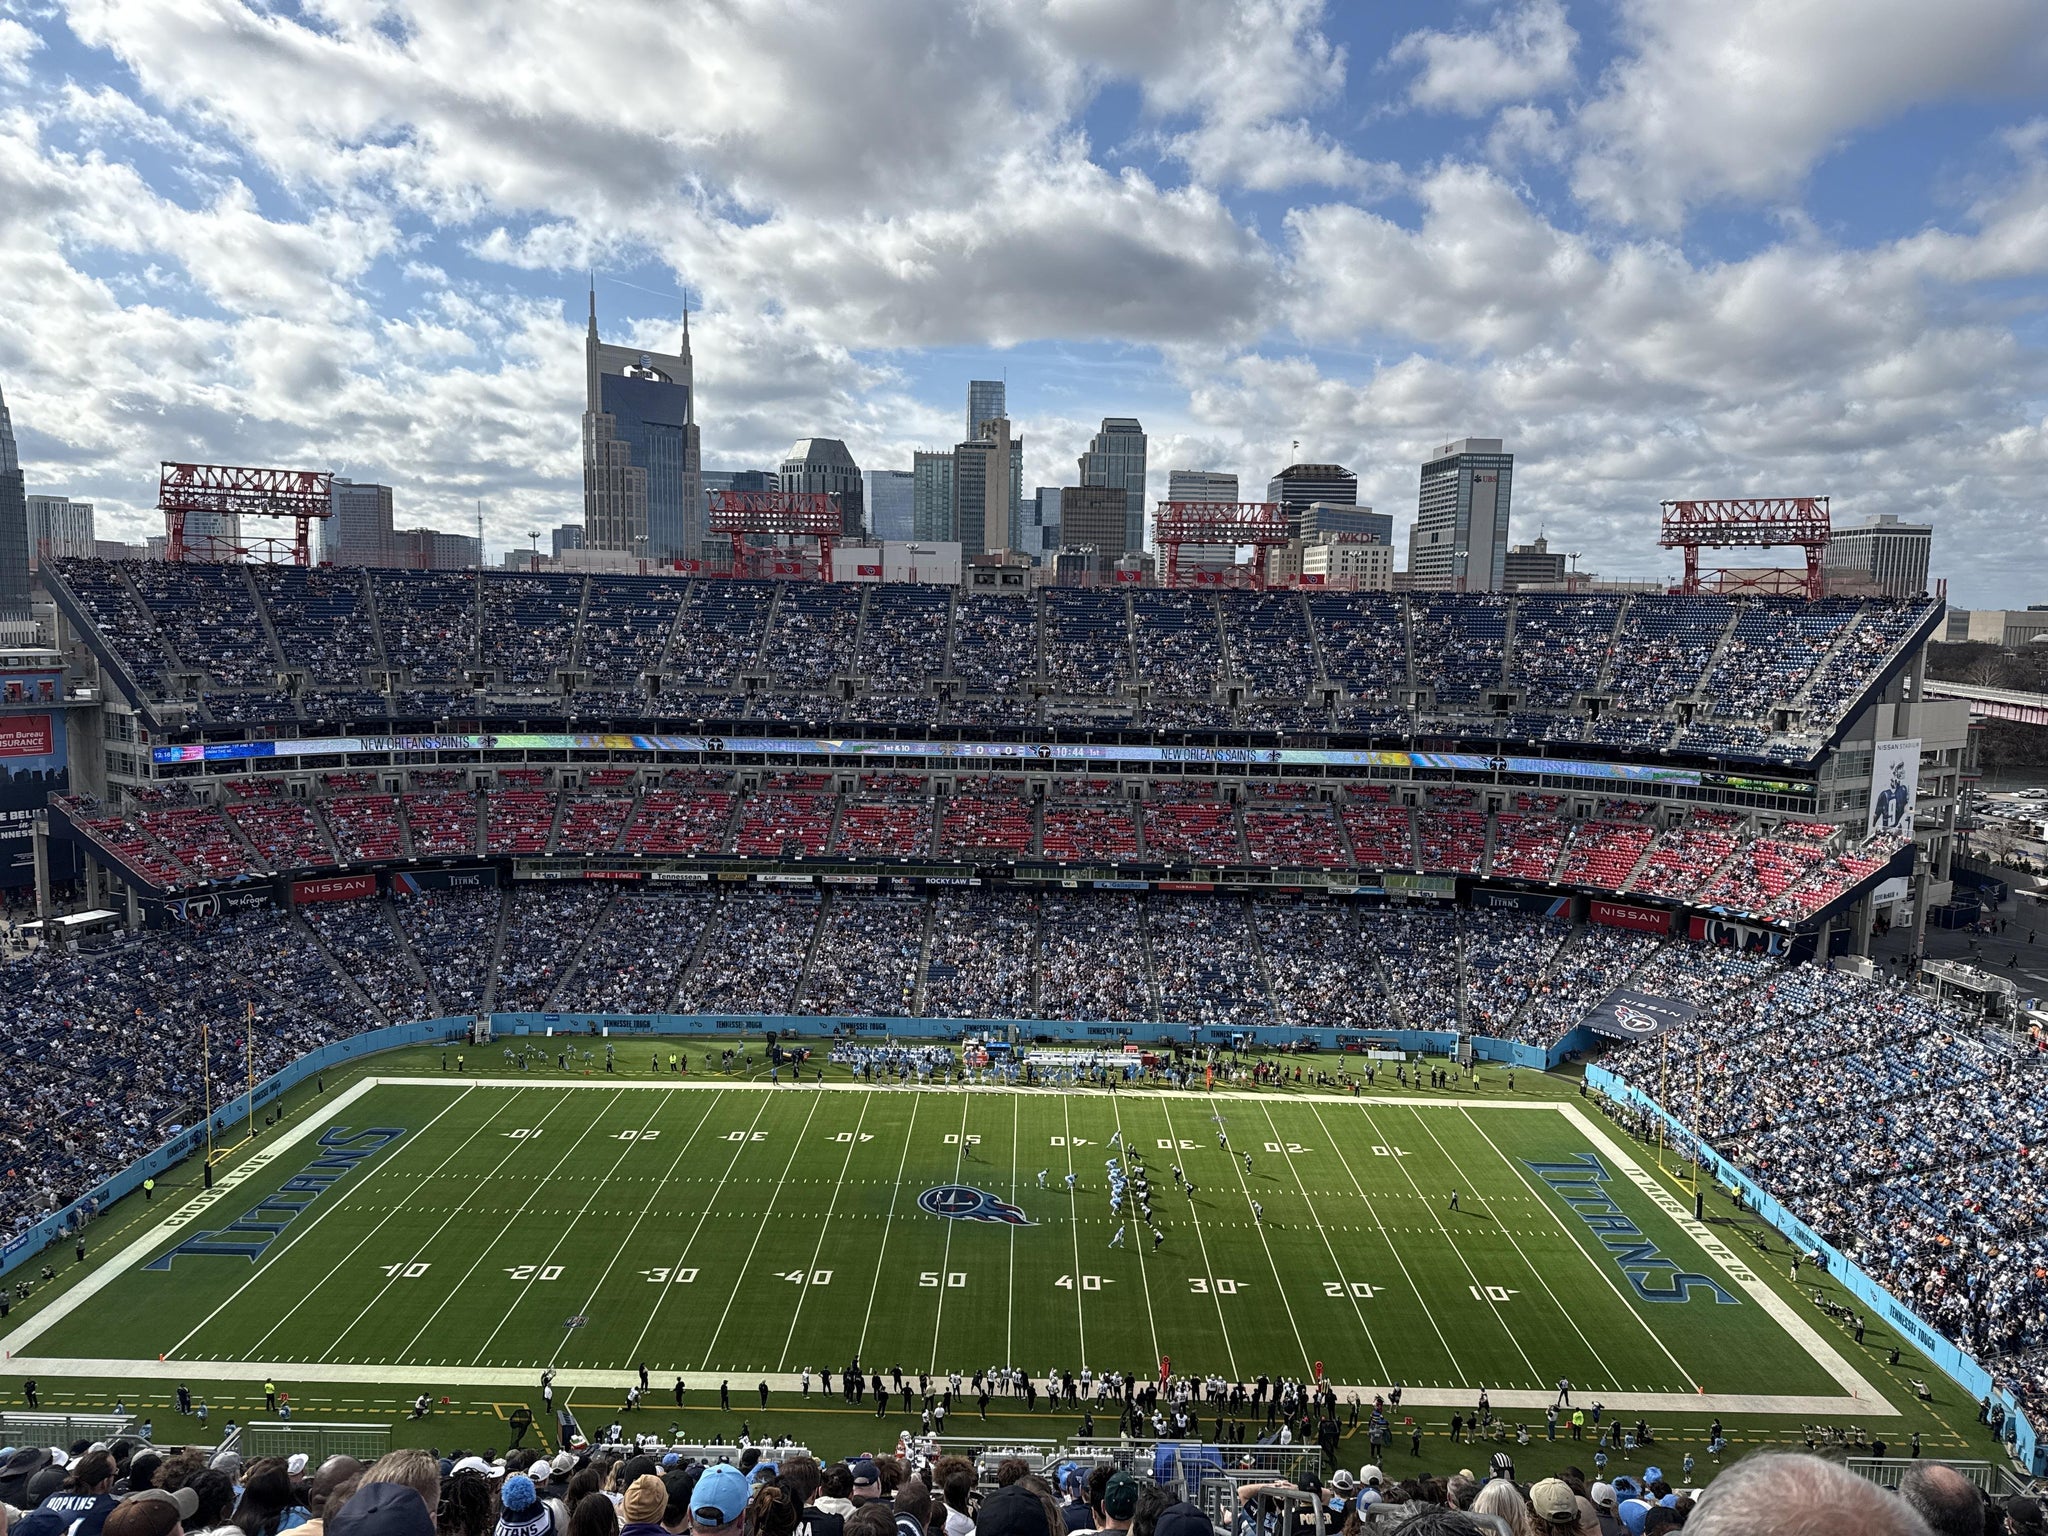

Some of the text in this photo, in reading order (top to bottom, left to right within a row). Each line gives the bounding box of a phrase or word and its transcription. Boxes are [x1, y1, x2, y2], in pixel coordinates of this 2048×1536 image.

[1338, 532, 1381, 543] WKDF
[361, 735, 469, 750] NEW ORLEANS SAINTS
[1877, 743, 1898, 751] NISSAN
[976, 746, 983, 754] 0
[1005, 746, 1012, 754] 0
[1056, 747, 1084, 756] 10:44
[1161, 748, 1257, 762] NEW ORLEANS SAINTS
[10, 808, 47, 820] BELI
[449, 874, 479, 886] TITANS
[304, 880, 366, 895] NISSAN
[240, 894, 269, 908] Kroger
[1488, 895, 1519, 908] TITANS
[1600, 906, 1660, 924] NISSAN
[1620, 998, 1681, 1017] NISSAN
[716, 1020, 743, 1029] TENNESSE
[1591, 1027, 1622, 1040] NISSAN
[509, 1128, 543, 1140] 10
[618, 1130, 661, 1141] 20
[727, 1131, 769, 1142] 30
[834, 1132, 874, 1143] 40
[943, 1134, 981, 1145] 50
[1050, 1136, 1086, 1147] 40
[1157, 1139, 1196, 1150] 30
[1264, 1142, 1303, 1153] 20
[1371, 1146, 1403, 1157] 10
[163, 1154, 275, 1227] CHOOSE LOVE
[140, 1126, 407, 1271] TITANS
[1521, 1153, 1743, 1305] TITANS
[1624, 1168, 1757, 1282] IT TAKES ALL OF US
[385, 1263, 432, 1278] 10
[510, 1265, 565, 1280] 20
[646, 1267, 700, 1283] 30
[783, 1269, 834, 1285] 40
[919, 1272, 967, 1288] 50
[1055, 1274, 1101, 1291] 40
[1188, 1277, 1237, 1294] 30
[1323, 1281, 1374, 1298] 20
[1469, 1285, 1510, 1302] 10
[1889, 1304, 1935, 1352] TENNESSEE TOUGH
[46, 1496, 97, 1512] HOPKINS
[1299, 1513, 1332, 1526] PORER
